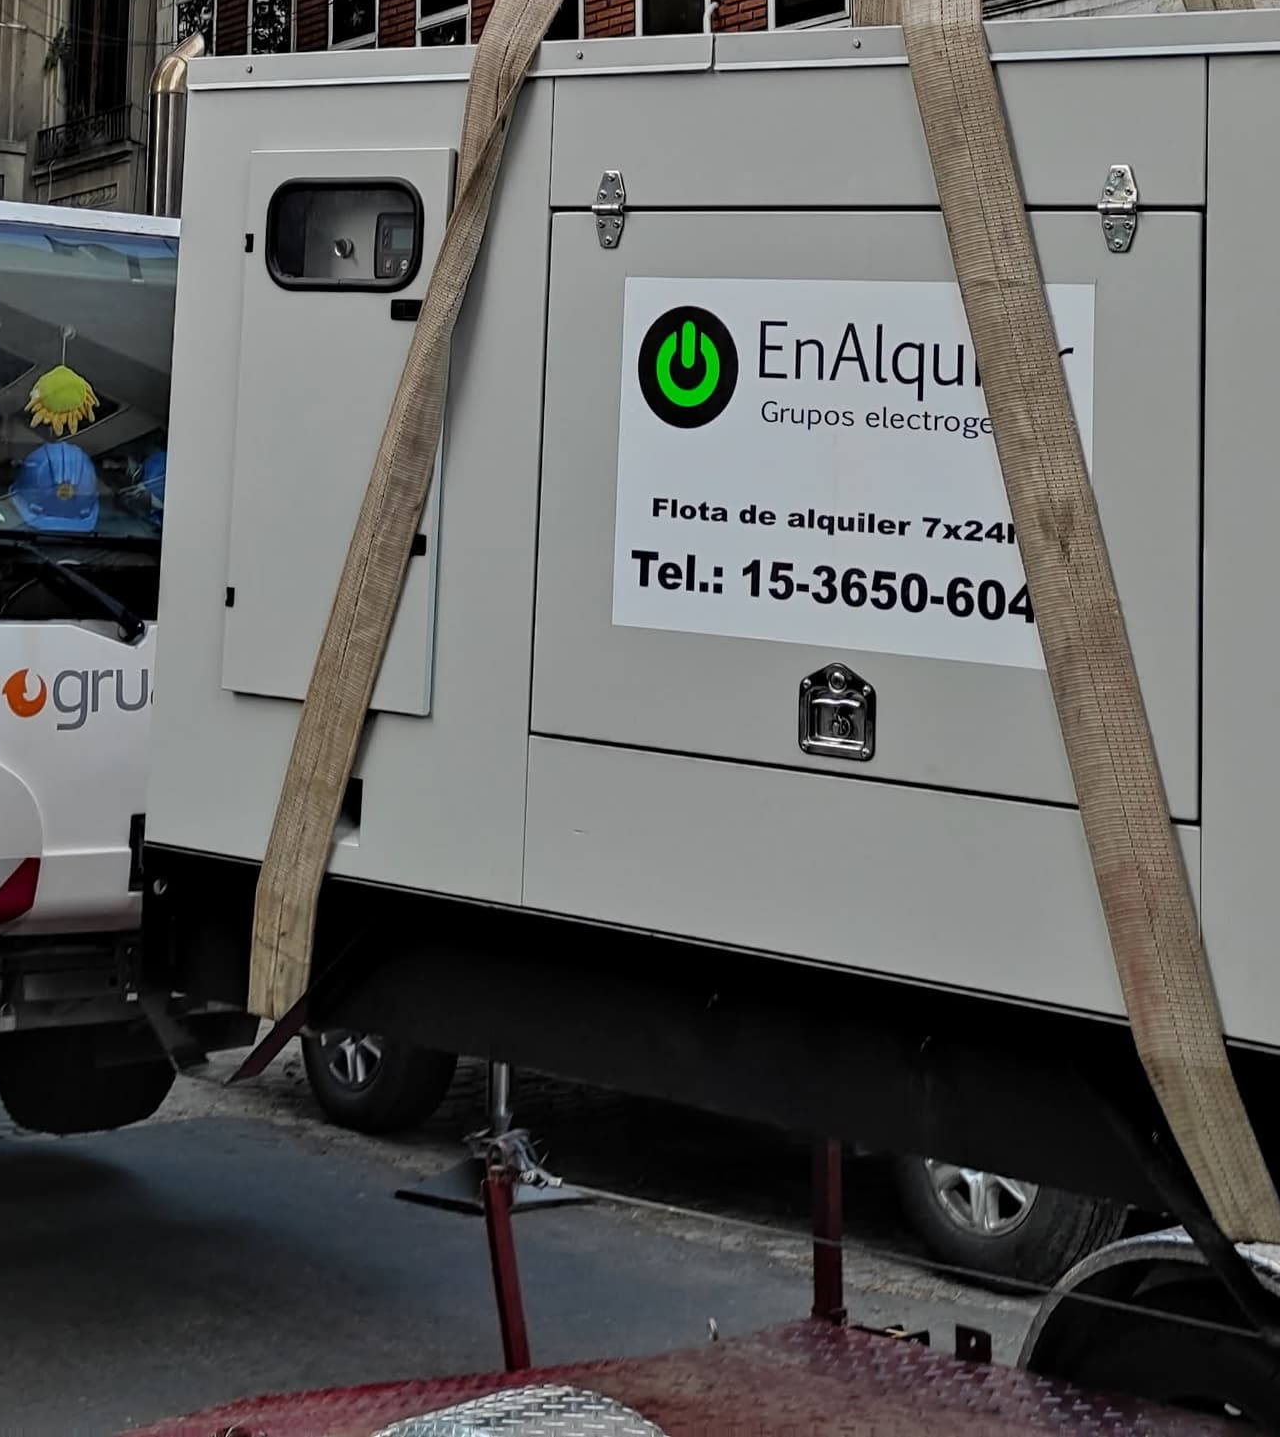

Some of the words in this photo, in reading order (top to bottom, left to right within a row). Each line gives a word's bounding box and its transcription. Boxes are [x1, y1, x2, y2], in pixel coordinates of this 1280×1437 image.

[758, 320, 1074, 401] EnAlqu
[761, 400, 855, 430] Grupos
[865, 405, 993, 440] electroge
[652, 497, 728, 523] Flota
[739, 504, 777, 526] de
[787, 508, 912, 536] alquiler
[631, 549, 724, 595] Tel.:
[742, 558, 1036, 624] 15-3650-604
[52, 668, 154, 731] gru
